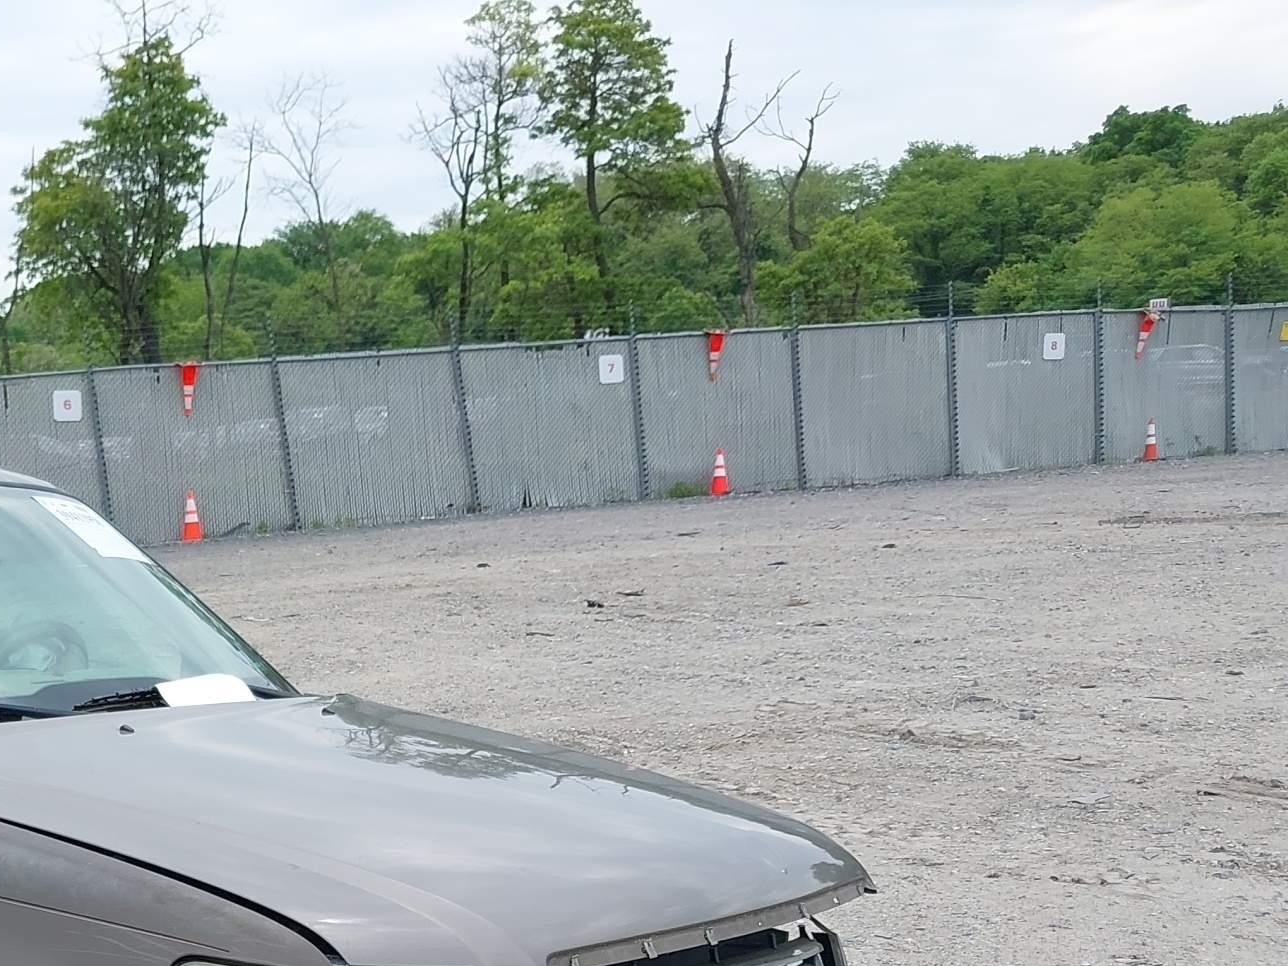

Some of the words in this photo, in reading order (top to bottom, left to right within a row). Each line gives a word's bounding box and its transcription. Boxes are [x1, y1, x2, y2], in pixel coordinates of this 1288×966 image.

[1050, 340, 1058, 351] 8
[607, 363, 616, 374] 7
[63, 399, 73, 410] 6
